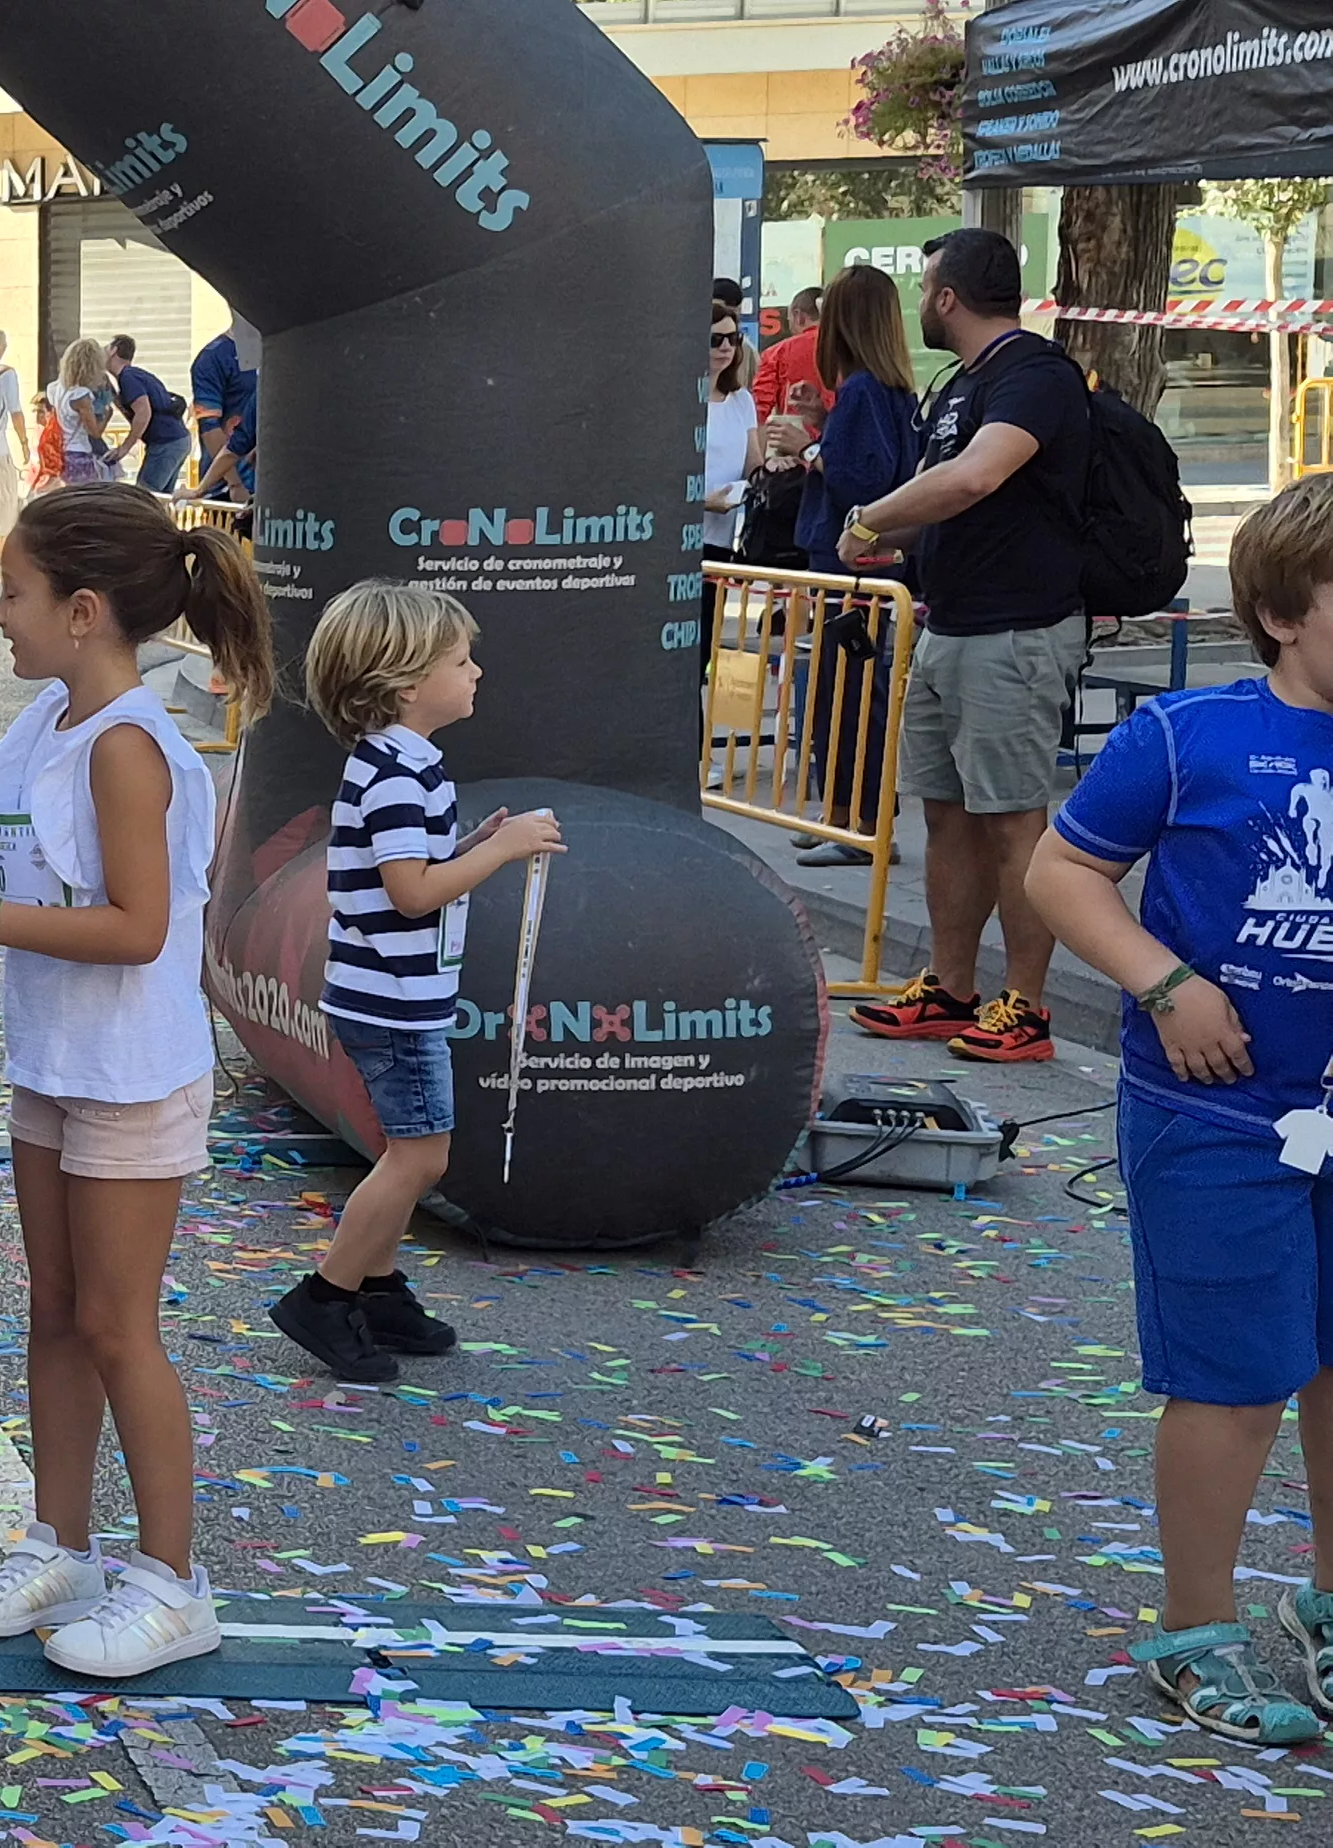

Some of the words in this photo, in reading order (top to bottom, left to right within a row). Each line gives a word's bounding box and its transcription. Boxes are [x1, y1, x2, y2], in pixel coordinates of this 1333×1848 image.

[388, 503, 655, 547] CroNoLimits
[417, 555, 480, 572] Servicio
[482, 555, 505, 572] de
[507, 554, 611, 572] cronometraje
[613, 555, 623, 571] y
[471, 576, 493, 592] de
[496, 575, 559, 592] eventos
[561, 572, 636, 592] deportivos
[518, 1052, 593, 1070] Servicio
[594, 1052, 621, 1070] de
[697, 1054, 711, 1071] y
[536, 1073, 657, 1094] promocional
[659, 1071, 745, 1092] deportivo
